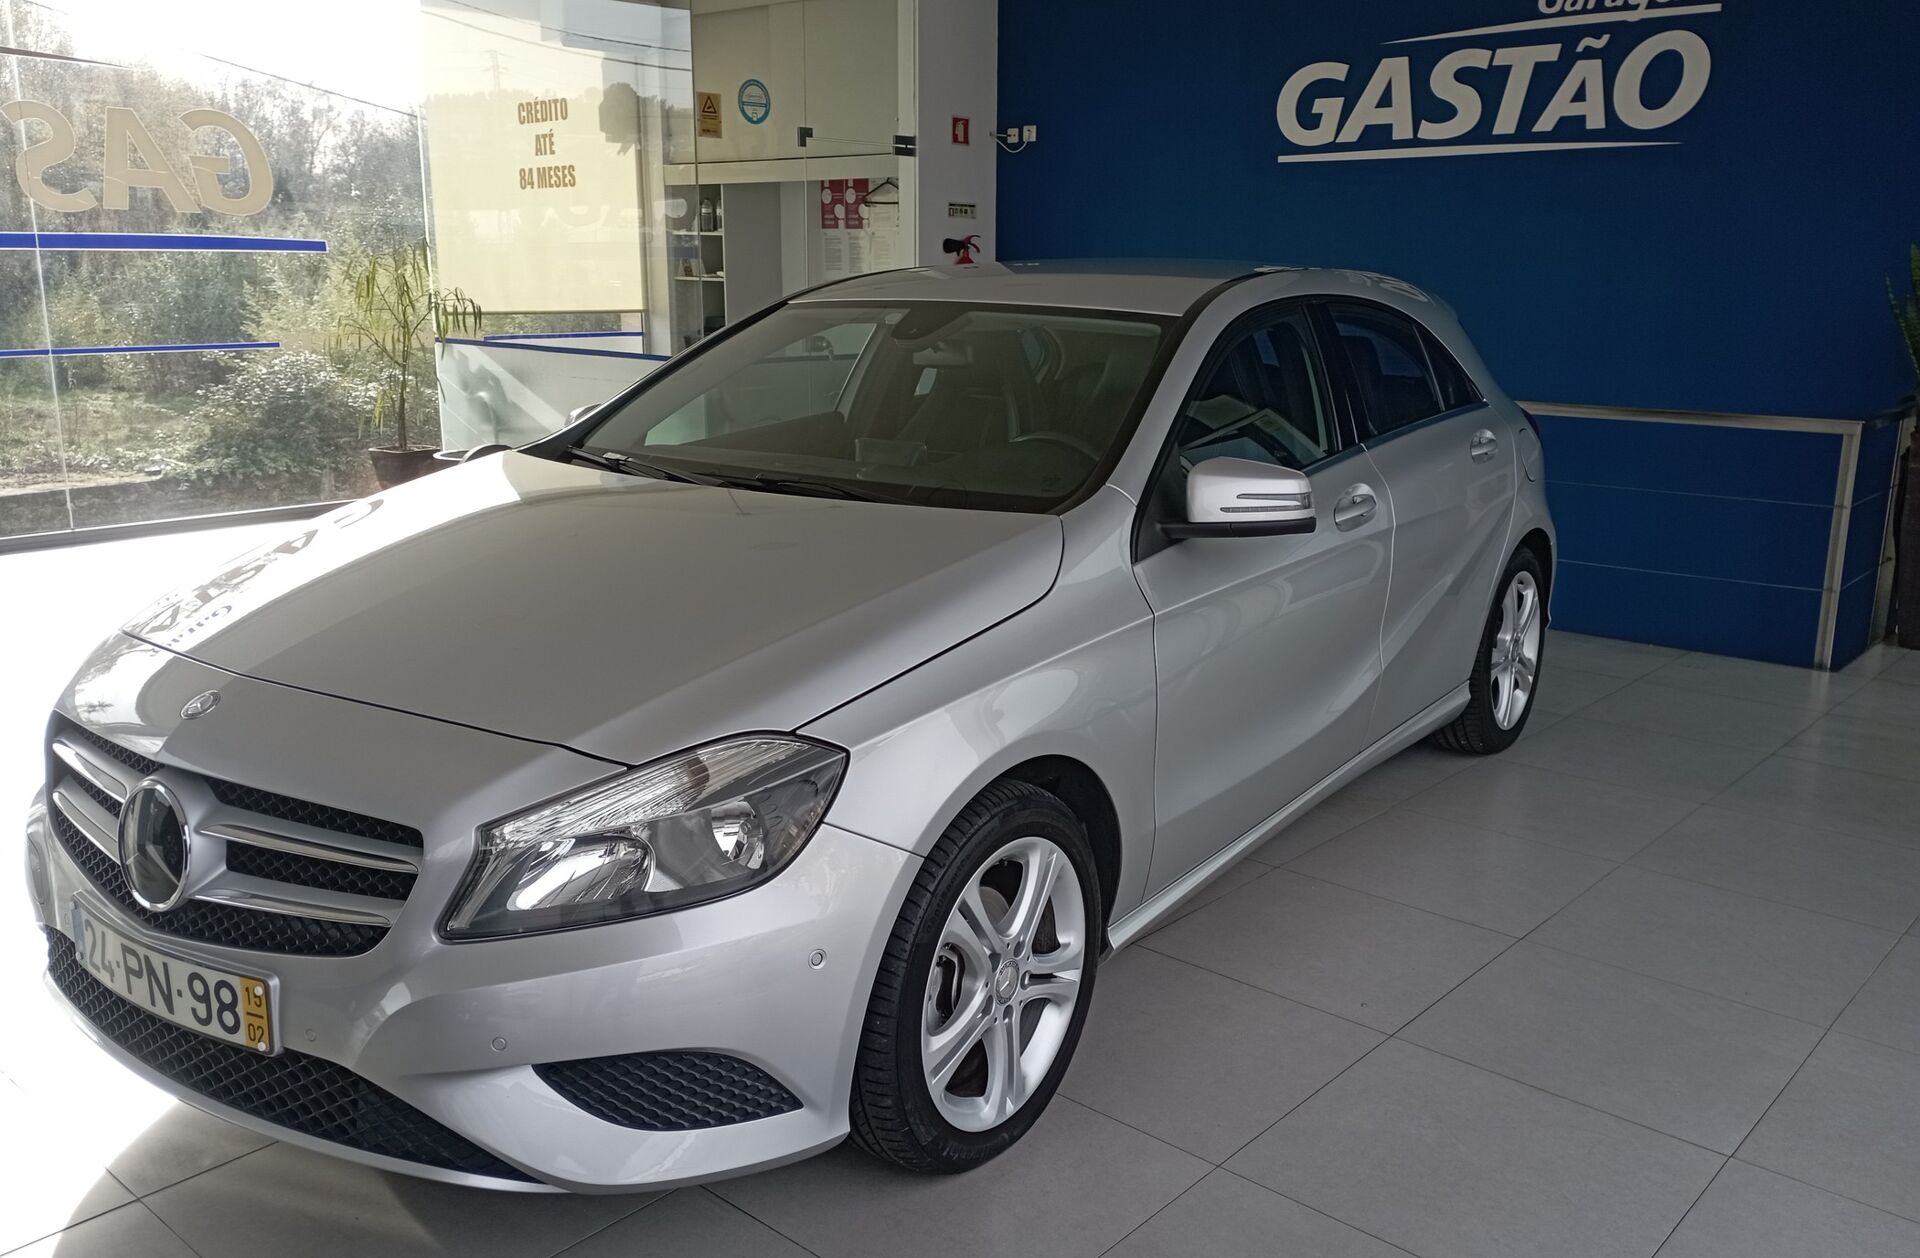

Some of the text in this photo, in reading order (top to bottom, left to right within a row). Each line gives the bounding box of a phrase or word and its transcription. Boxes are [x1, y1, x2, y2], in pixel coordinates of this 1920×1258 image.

[1538, 0, 1681, 22] Garg
[1276, 29, 1711, 147] GASTÃO
[518, 96, 568, 125] CRÉDITO
[535, 128, 556, 156] ATÉ
[519, 164, 576, 190] 84 MESES
[248, 1022, 265, 1046] 02
